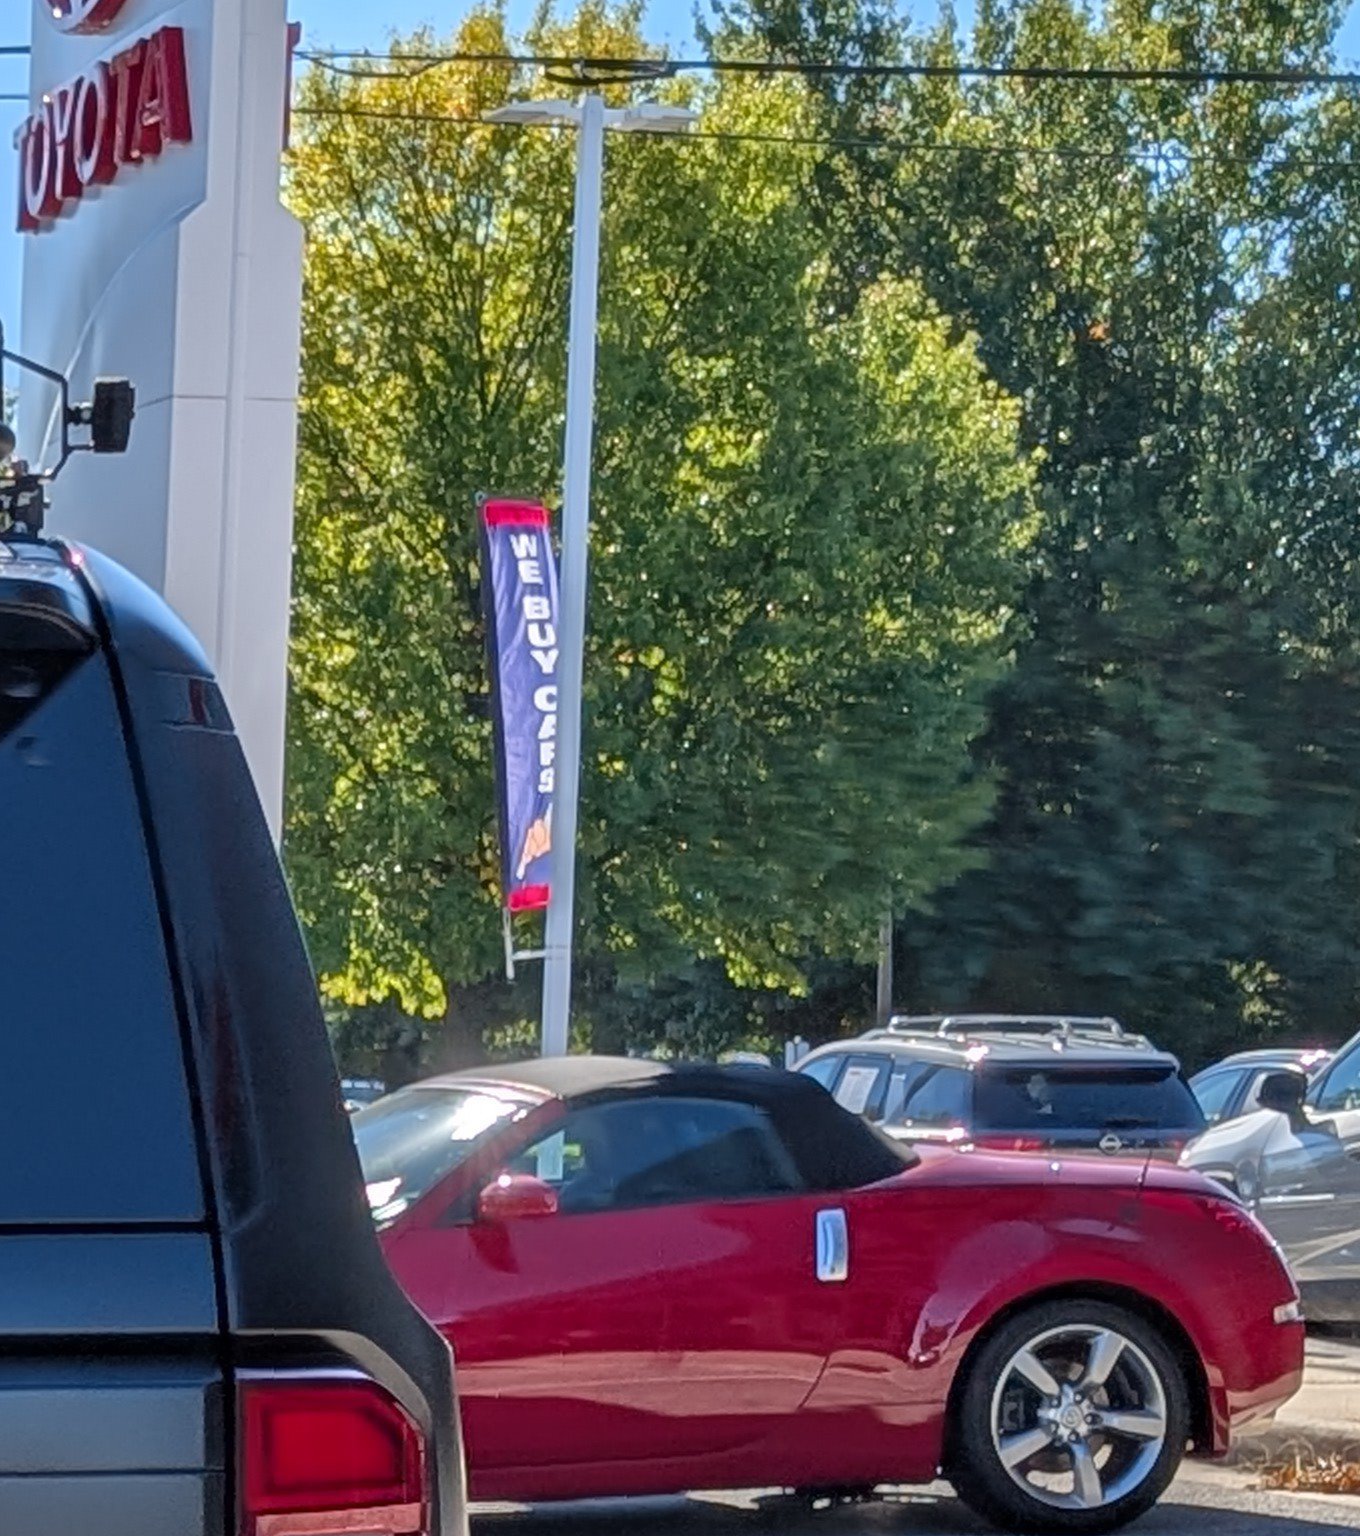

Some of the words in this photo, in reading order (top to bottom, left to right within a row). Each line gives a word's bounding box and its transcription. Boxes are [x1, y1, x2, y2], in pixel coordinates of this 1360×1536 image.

[13, 26, 192, 234] TOYOTA
[509, 533, 544, 585] WE
[522, 595, 559, 674] BUY
